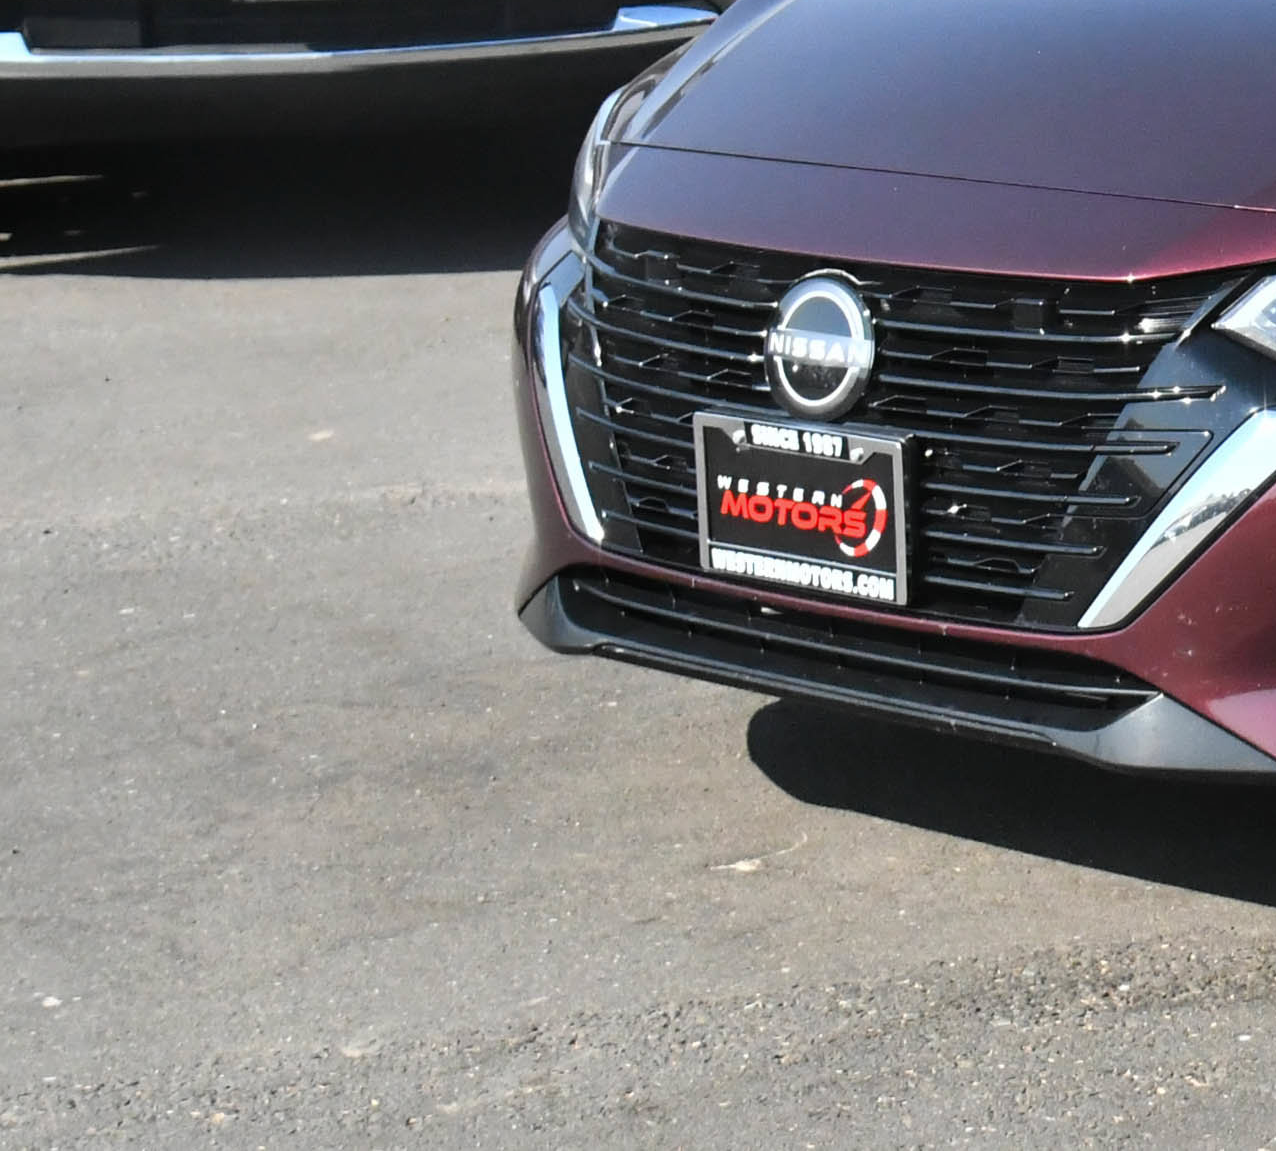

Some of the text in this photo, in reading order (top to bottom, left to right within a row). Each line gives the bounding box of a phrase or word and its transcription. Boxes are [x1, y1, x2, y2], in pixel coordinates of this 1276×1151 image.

[769, 331, 871, 364] NISSAN
[751, 424, 800, 451] SINCE
[717, 475, 843, 509] WESTERN
[720, 487, 867, 539] MOTORS
[711, 547, 895, 601] WESTERNMOTORS.COM
